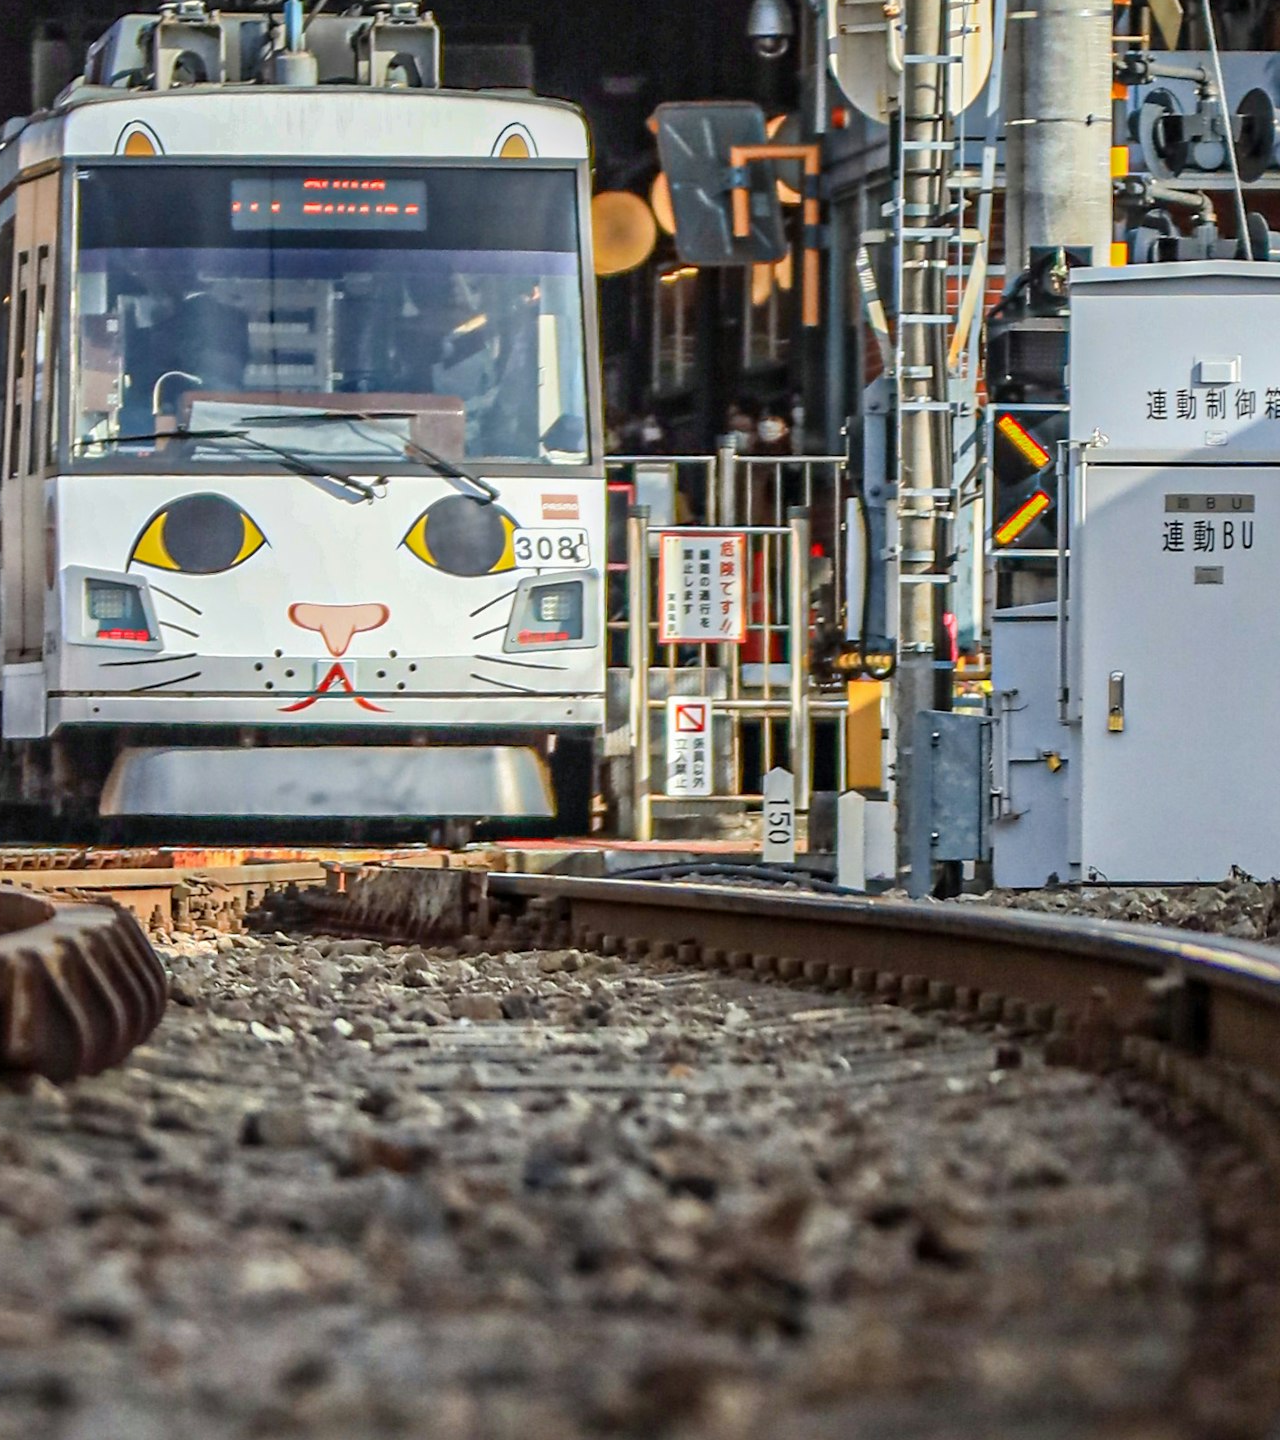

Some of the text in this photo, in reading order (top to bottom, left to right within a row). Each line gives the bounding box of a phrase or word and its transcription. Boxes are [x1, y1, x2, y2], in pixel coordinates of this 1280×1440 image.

[515, 536, 574, 561] 308
[1162, 520, 1253, 552] 連動BU
[768, 798, 791, 845] 150
